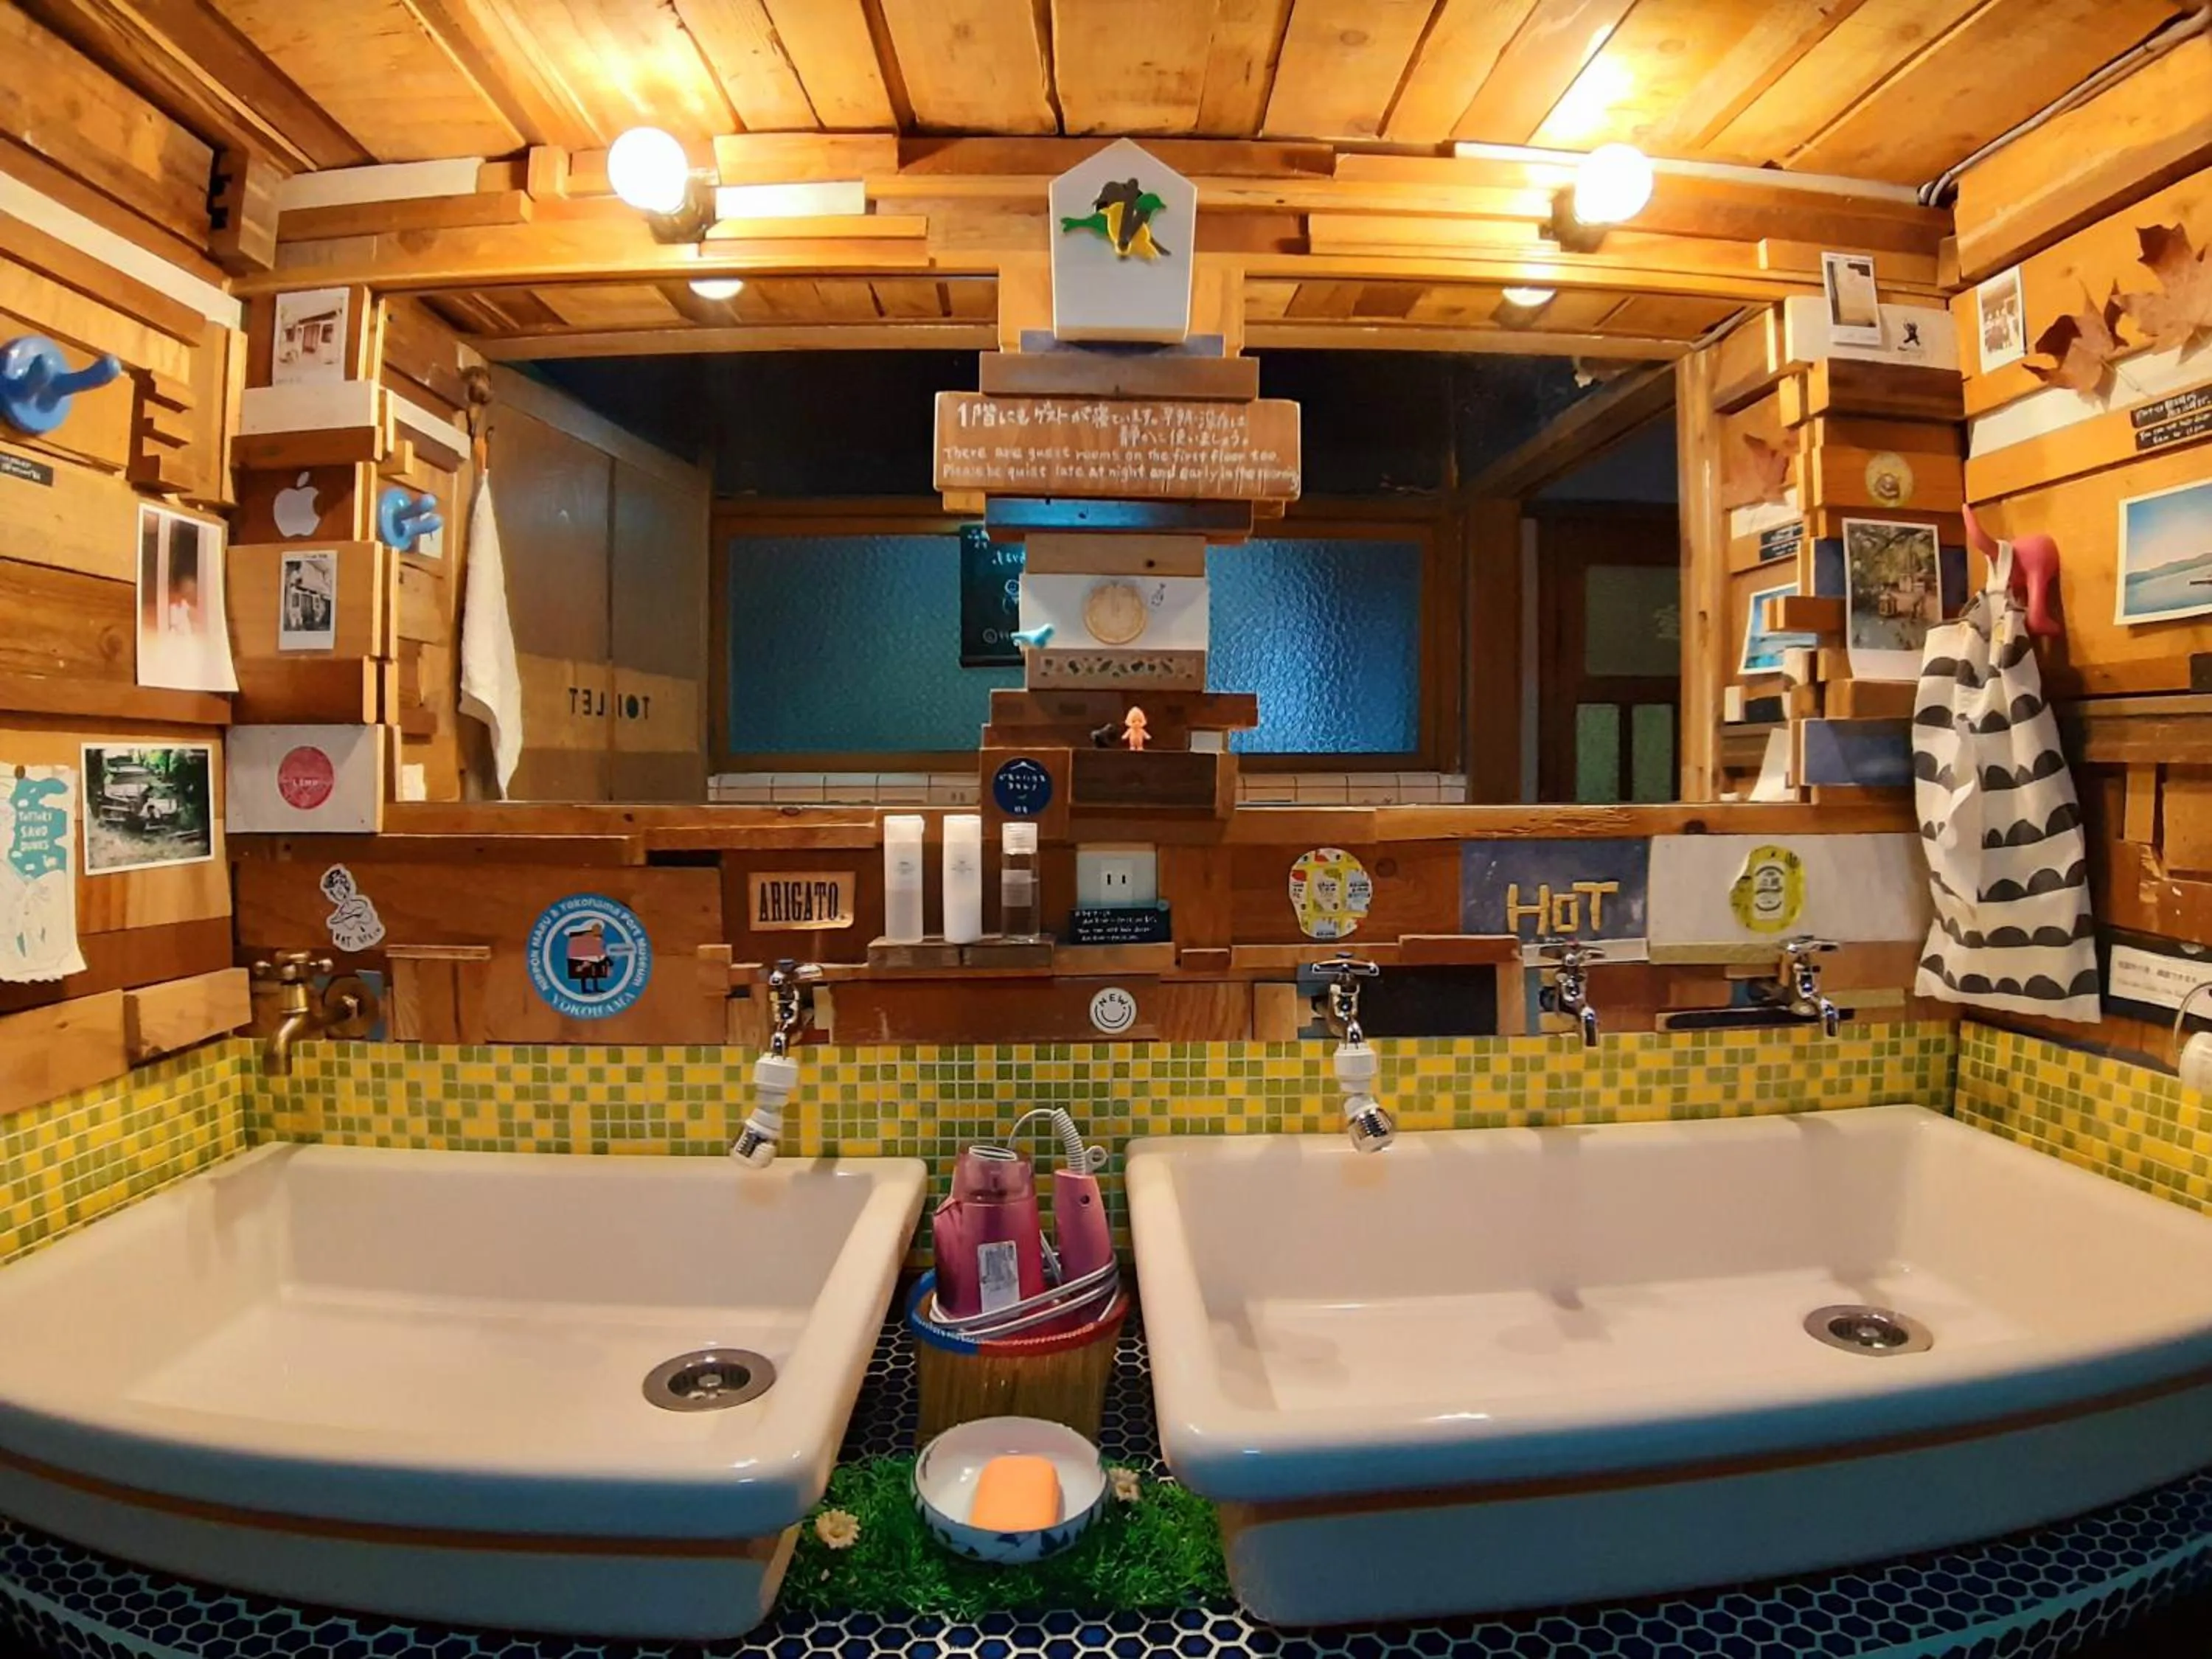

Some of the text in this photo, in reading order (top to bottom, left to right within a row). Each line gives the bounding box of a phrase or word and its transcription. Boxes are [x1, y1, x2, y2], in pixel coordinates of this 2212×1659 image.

[943, 447, 987, 459] There
[1028, 448, 1070, 462] guest
[1076, 449, 1120, 461] rooms
[1125, 451, 1142, 460] on
[1148, 448, 1169, 461] the
[1173, 448, 1206, 464] first
[1210, 448, 1245, 463] floor
[1007, 463, 1046, 481] quiet
[1055, 465, 1085, 478] late
[1108, 464, 1145, 483] night
[1180, 465, 1219, 484] early
[21, 825, 49, 838] SAND
[1506, 882, 1619, 935] HOT
[531, 916, 552, 947] MARU
[559, 898, 621, 915] Yokohama
[620, 912, 642, 936] Port
[631, 937, 648, 987] Museum
[552, 992, 636, 1016] YOKOHAMA
